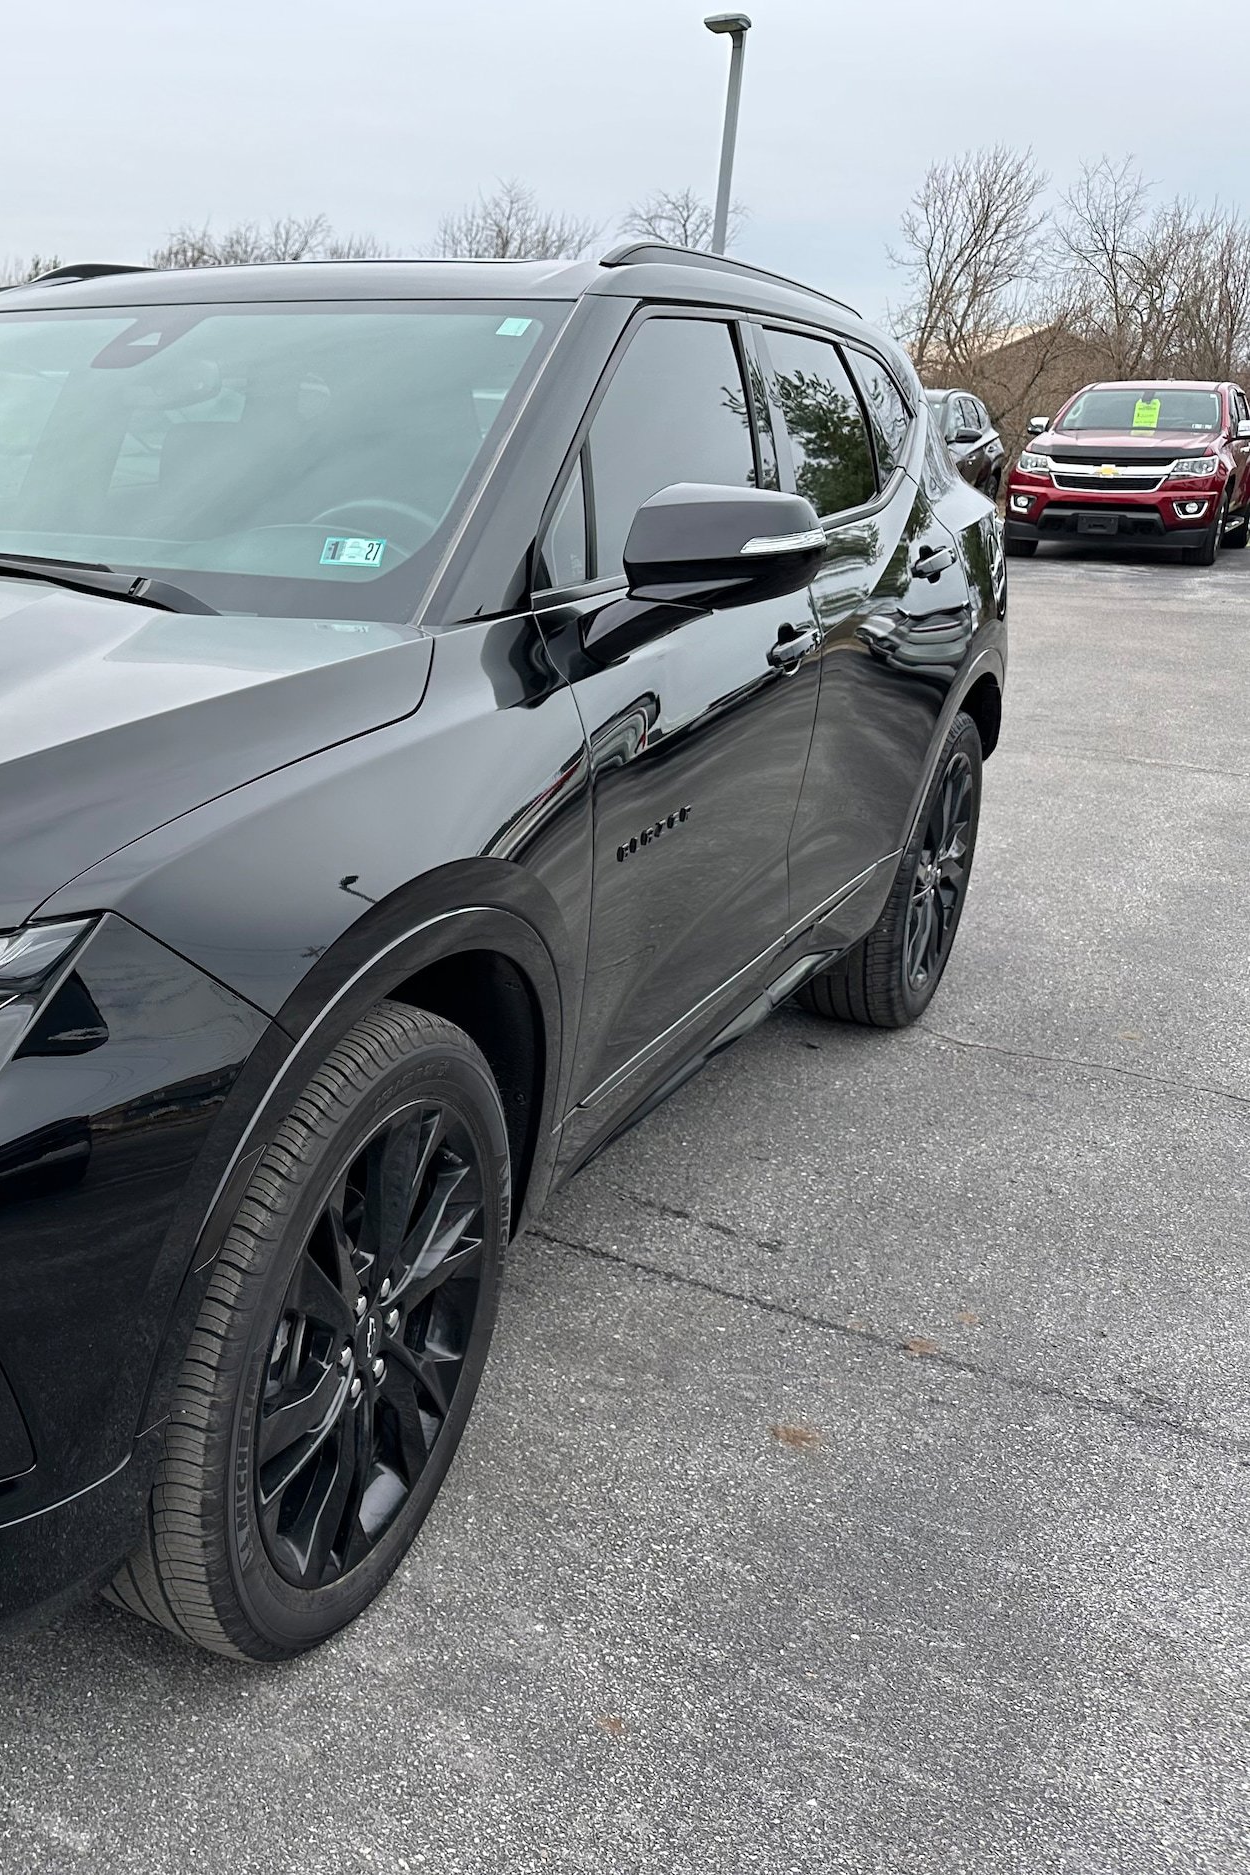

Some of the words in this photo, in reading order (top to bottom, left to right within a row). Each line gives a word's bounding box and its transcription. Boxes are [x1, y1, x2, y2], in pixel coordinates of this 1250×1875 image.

[330, 541, 340, 560] 1
[364, 542, 382, 561] 27
[616, 805, 692, 862] BLAZER
[236, 1369, 259, 1532] MICHELIN
